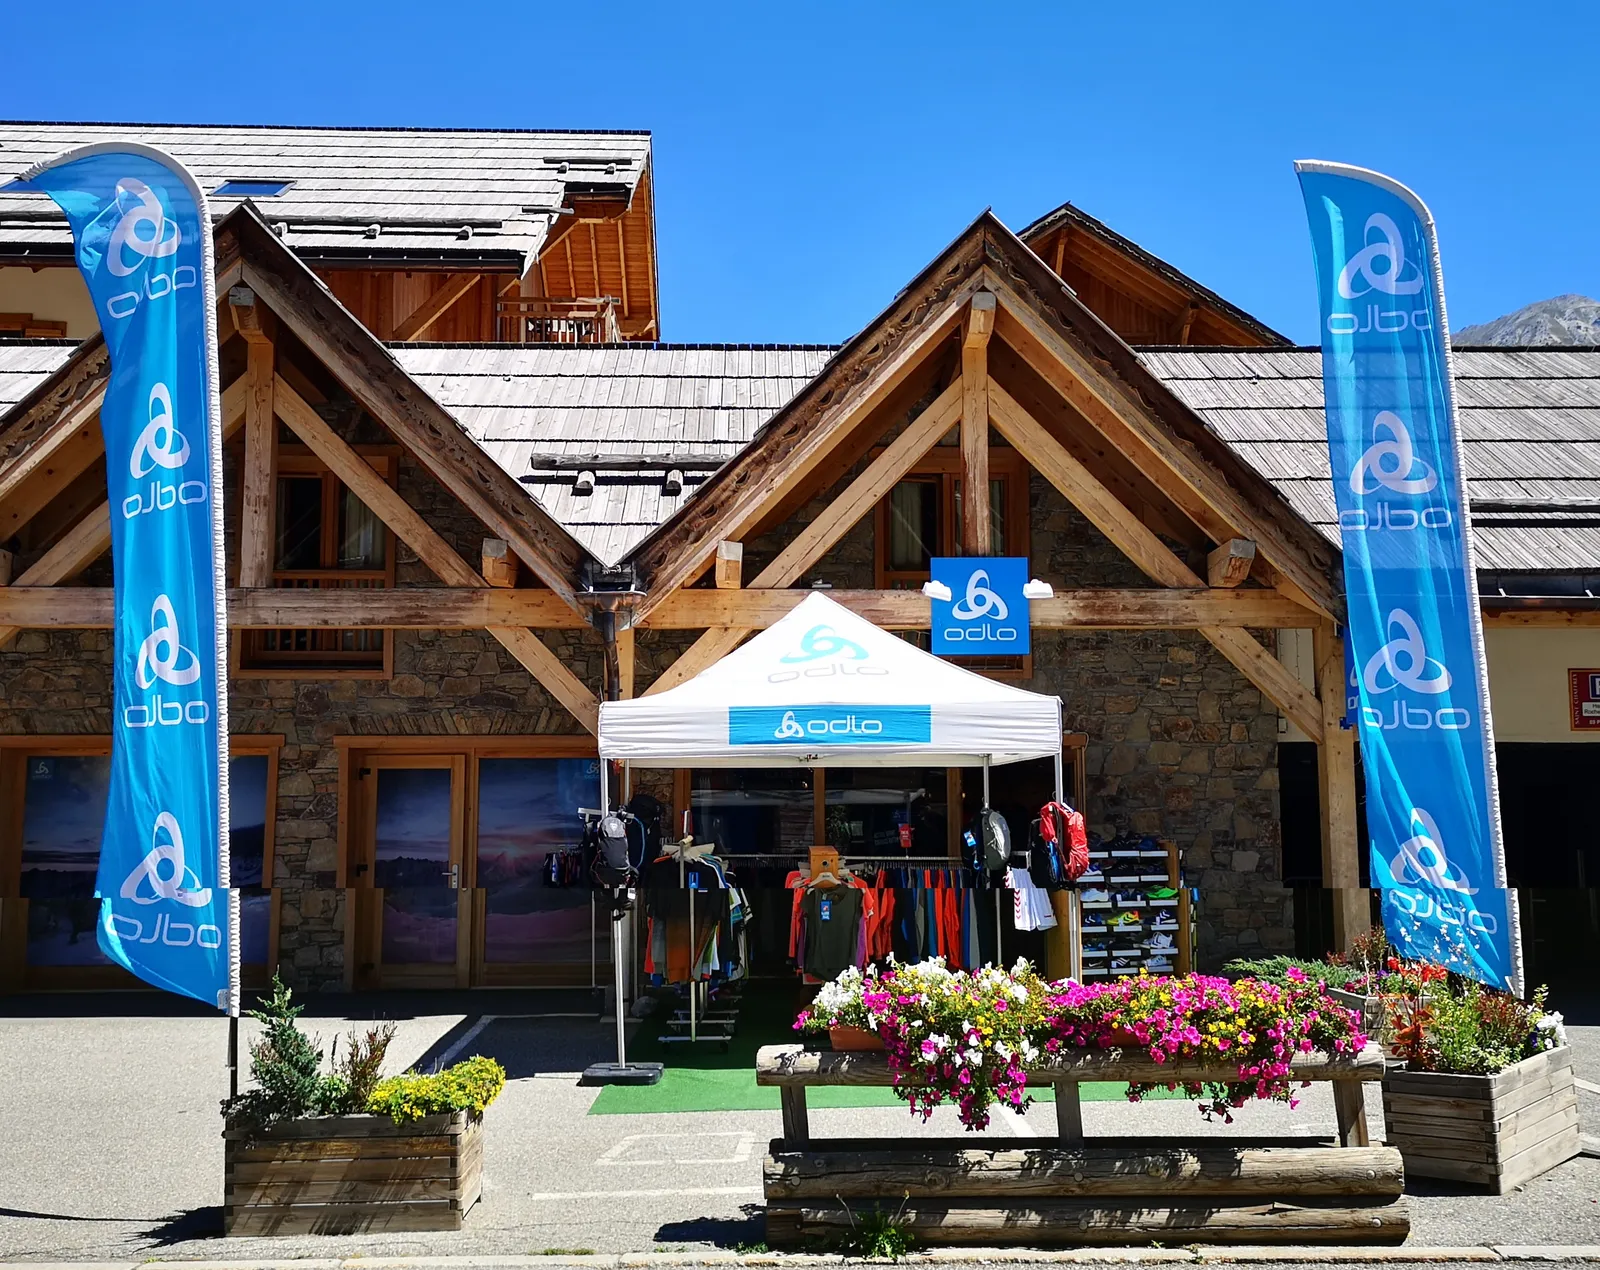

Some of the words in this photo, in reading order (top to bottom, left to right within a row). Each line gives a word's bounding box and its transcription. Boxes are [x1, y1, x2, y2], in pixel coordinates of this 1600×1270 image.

[943, 621, 1018, 641] odlo
[767, 663, 890, 684] odlo
[807, 714, 883, 735] odlo
